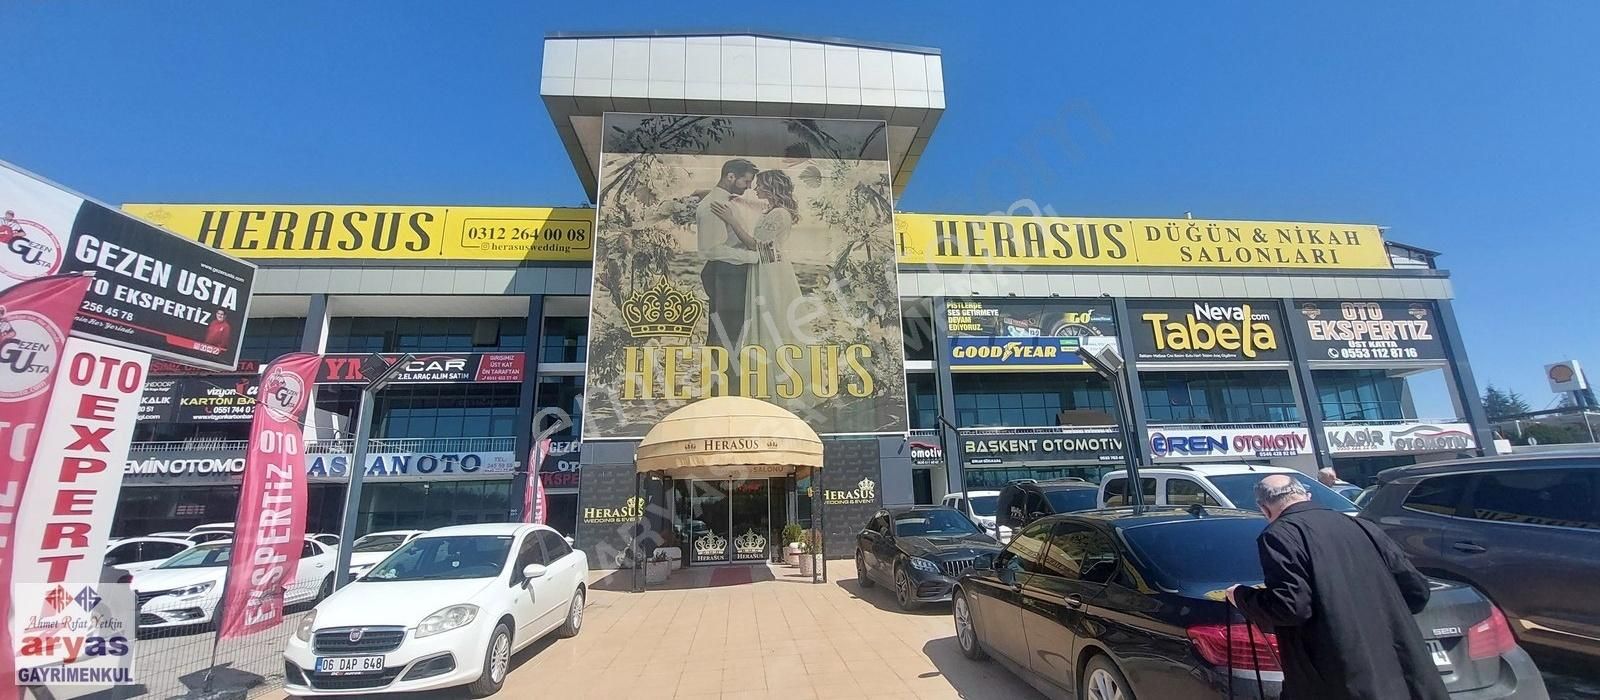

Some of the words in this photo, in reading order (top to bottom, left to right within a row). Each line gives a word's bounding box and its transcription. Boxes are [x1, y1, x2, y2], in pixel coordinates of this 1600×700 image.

[197, 210, 433, 252] HERASUS
[468, 227, 505, 240] 0312
[512, 228, 538, 241] 264
[543, 228, 563, 241] 00
[567, 229, 585, 242] 08
[933, 220, 1127, 260] HERASUS
[1145, 222, 1242, 243] DÜĞÜN
[1252, 228, 1268, 243] &
[1277, 226, 1361, 246] NİKAH
[1181, 246, 1340, 264] SALONLARI
[75, 234, 175, 288] GEZEN
[177, 268, 237, 311] USTA
[82, 301, 103, 312] 256
[105, 307, 119, 317] 45
[121, 311, 134, 321] 78
[114, 284, 211, 326] EKSPERTİZ
[1194, 302, 1243, 321] Neva
[1341, 302, 1383, 320] OTO
[1142, 304, 1277, 357] Tabela
[953, 344, 1056, 358] GOODYEAR
[1341, 348, 1370, 358] 0553
[1372, 348, 1390, 358] 112
[69, 352, 141, 394] OTO
[405, 360, 466, 371] CAR
[620, 343, 874, 400] HERASUS
[207, 387, 236, 398] vizyon
[260, 429, 297, 454] OTO
[703, 439, 759, 451] HERASUS
[965, 439, 1038, 455] BAŞKENT
[1043, 438, 1123, 452] OTOMOTİV
[1232, 431, 1307, 452] OTOMOTİV
[169, 459, 245, 474] OTOMO
[308, 455, 411, 477] ASAN
[416, 454, 481, 473] OTO
[37, 394, 119, 612] EXPERT
[322, 659, 334, 670] 06
[340, 658, 357, 670] DAP
[363, 657, 382, 669] 648
